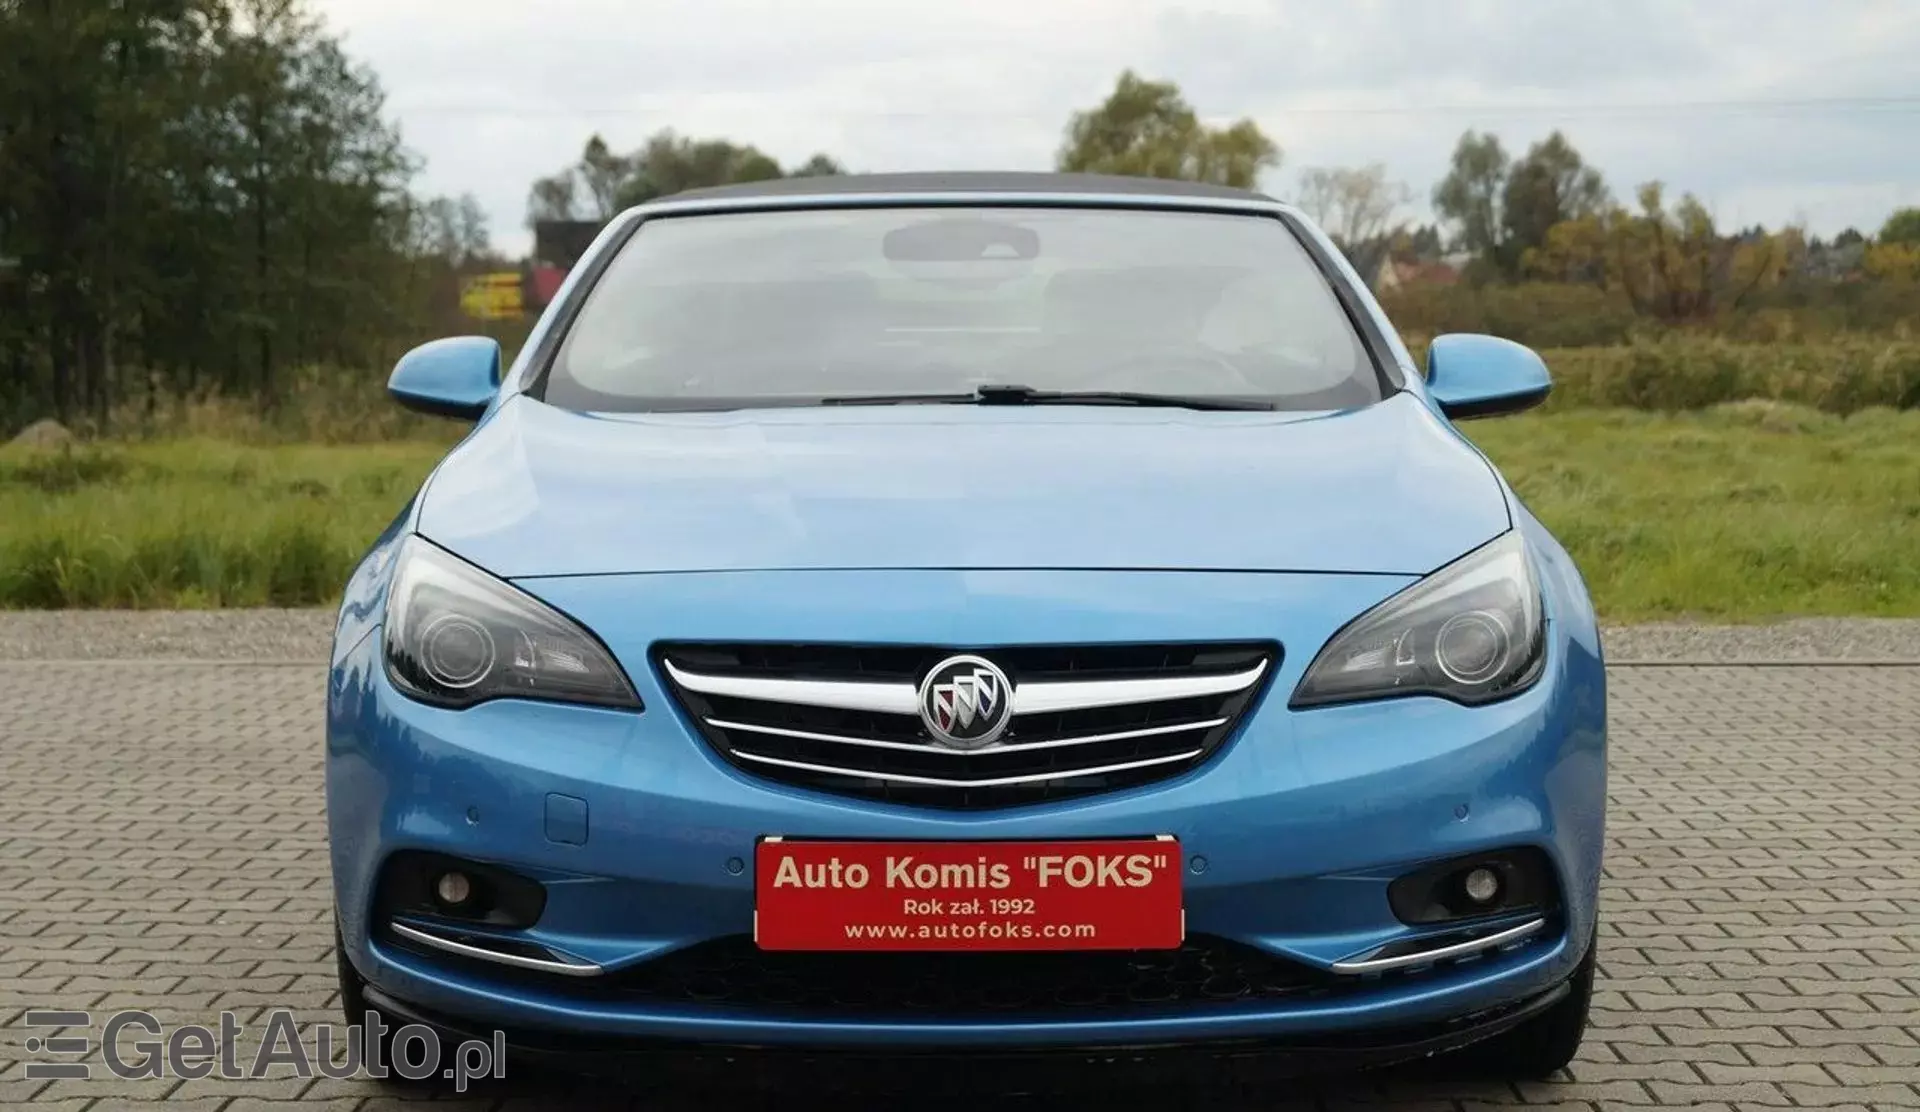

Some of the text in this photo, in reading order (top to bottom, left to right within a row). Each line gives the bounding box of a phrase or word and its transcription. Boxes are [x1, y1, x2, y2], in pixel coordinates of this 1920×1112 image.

[773, 855, 1167, 889] Auto Komis "FOKS"
[903, 898, 1035, 915] Rok zał. 1992
[844, 920, 1096, 939] www.autofoks.com
